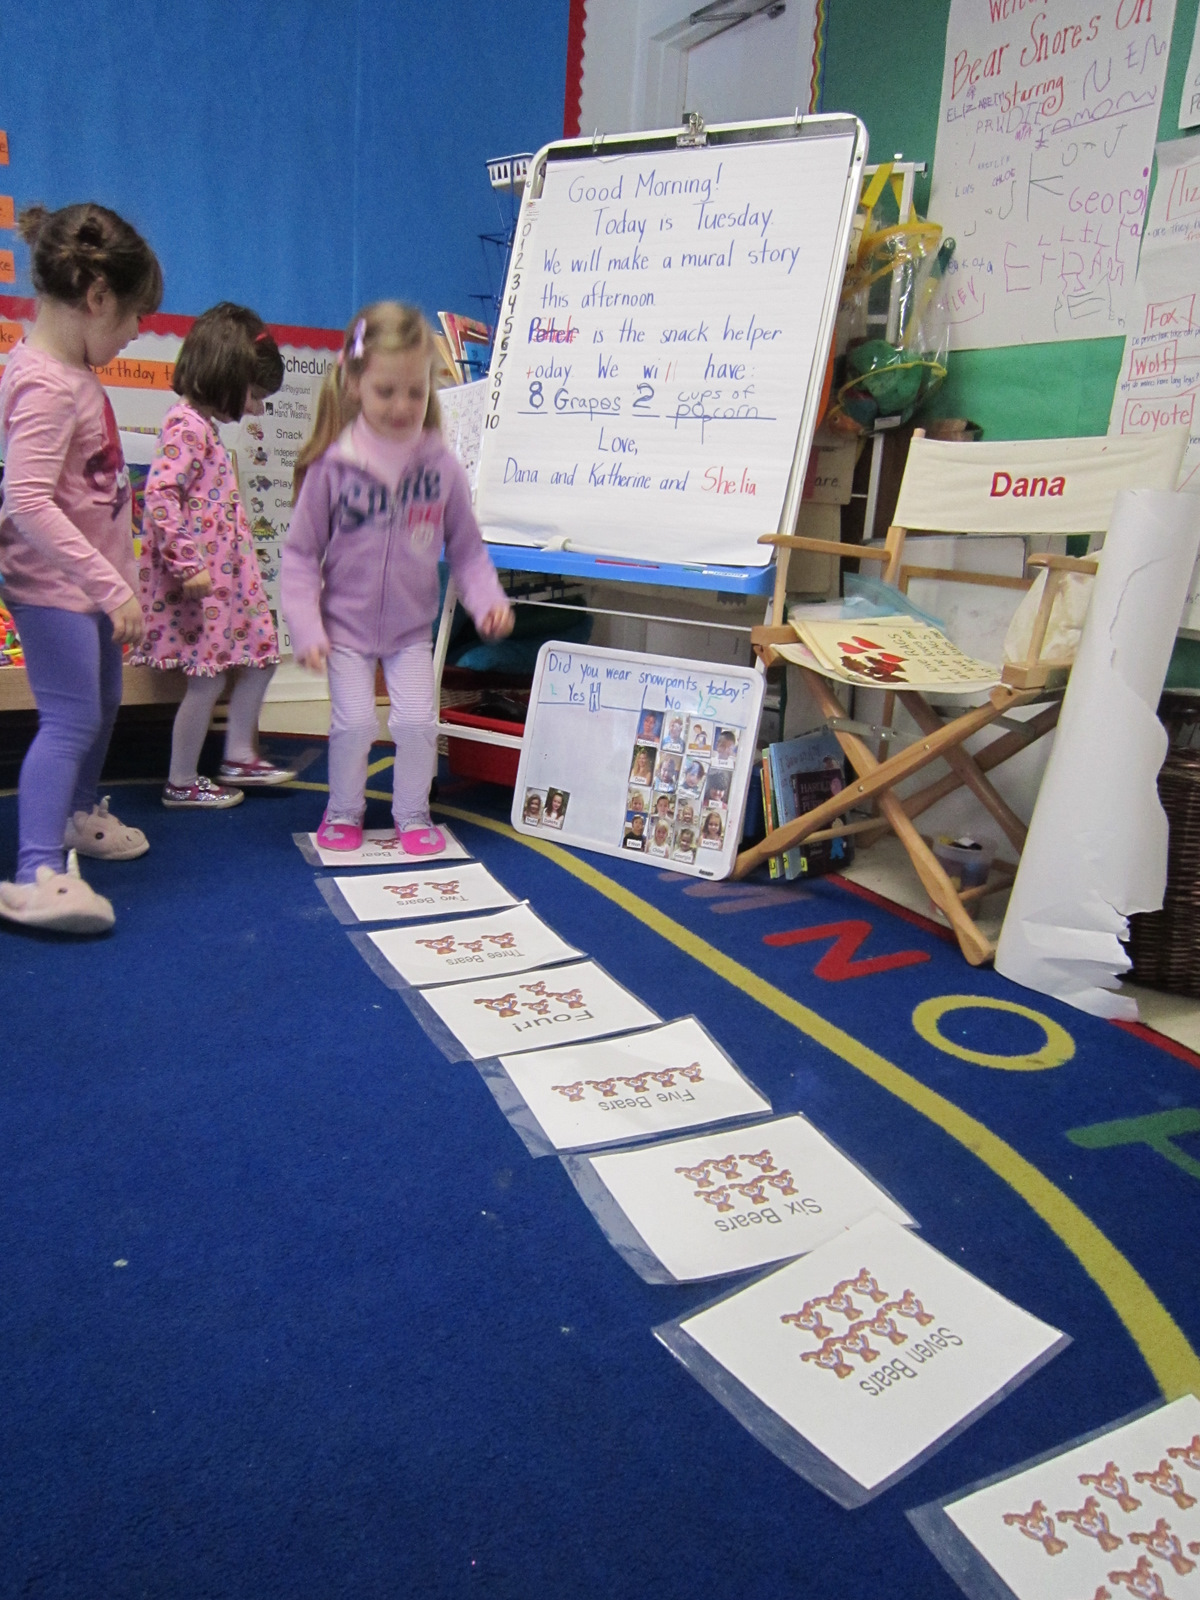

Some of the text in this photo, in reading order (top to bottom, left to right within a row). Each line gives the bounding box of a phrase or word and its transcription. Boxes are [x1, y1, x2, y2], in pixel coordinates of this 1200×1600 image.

[950, 43, 1010, 100] Bear
[1019, 12, 1102, 68] Snores
[1000, 75, 1064, 116] starring
[568, 162, 723, 203] Good Morning!
[594, 206, 648, 243] Today
[659, 214, 673, 231] is
[514, 252, 524, 270] 2
[543, 238, 801, 275] We will make a mural story
[511, 273, 521, 290] 3
[508, 294, 517, 315] 4
[540, 282, 569, 309] this
[503, 316, 515, 334] 5
[1150, 303, 1179, 329] Fox
[500, 336, 509, 351] 6
[593, 324, 605, 343] is
[619, 318, 646, 342] the
[660, 317, 709, 342] snack
[723, 314, 783, 350] helper
[497, 353, 508, 368] 7
[597, 351, 620, 379] We
[643, 358, 678, 383] will
[1135, 347, 1171, 377] Wolf
[494, 371, 503, 388] 8
[491, 390, 500, 411] 9
[529, 381, 756, 421] 8 Grapes 2 cups of
[274, 409, 311, 420] Hand Washing
[485, 414, 500, 430] 10
[1129, 403, 1191, 432] Coyote
[276, 428, 303, 440] Snack
[597, 427, 639, 455] Love,
[503, 457, 756, 496] Dana and Katherine and Shelia
[989, 471, 1067, 498] Dana
[548, 653, 751, 702] Did you wear snowpants today?
[568, 683, 585, 702] Yes
[664, 695, 681, 710] No
[360, 850, 392, 859] Bear
[396, 894, 470, 907] Two Bears
[445, 949, 526, 966] Three Bears
[512, 1009, 595, 1033] Four!
[911, 994, 1076, 1072] O
[598, 1088, 695, 1112] Five Bears
[714, 1197, 823, 1233] Six Bears
[858, 1326, 964, 1397] Seven Bears
